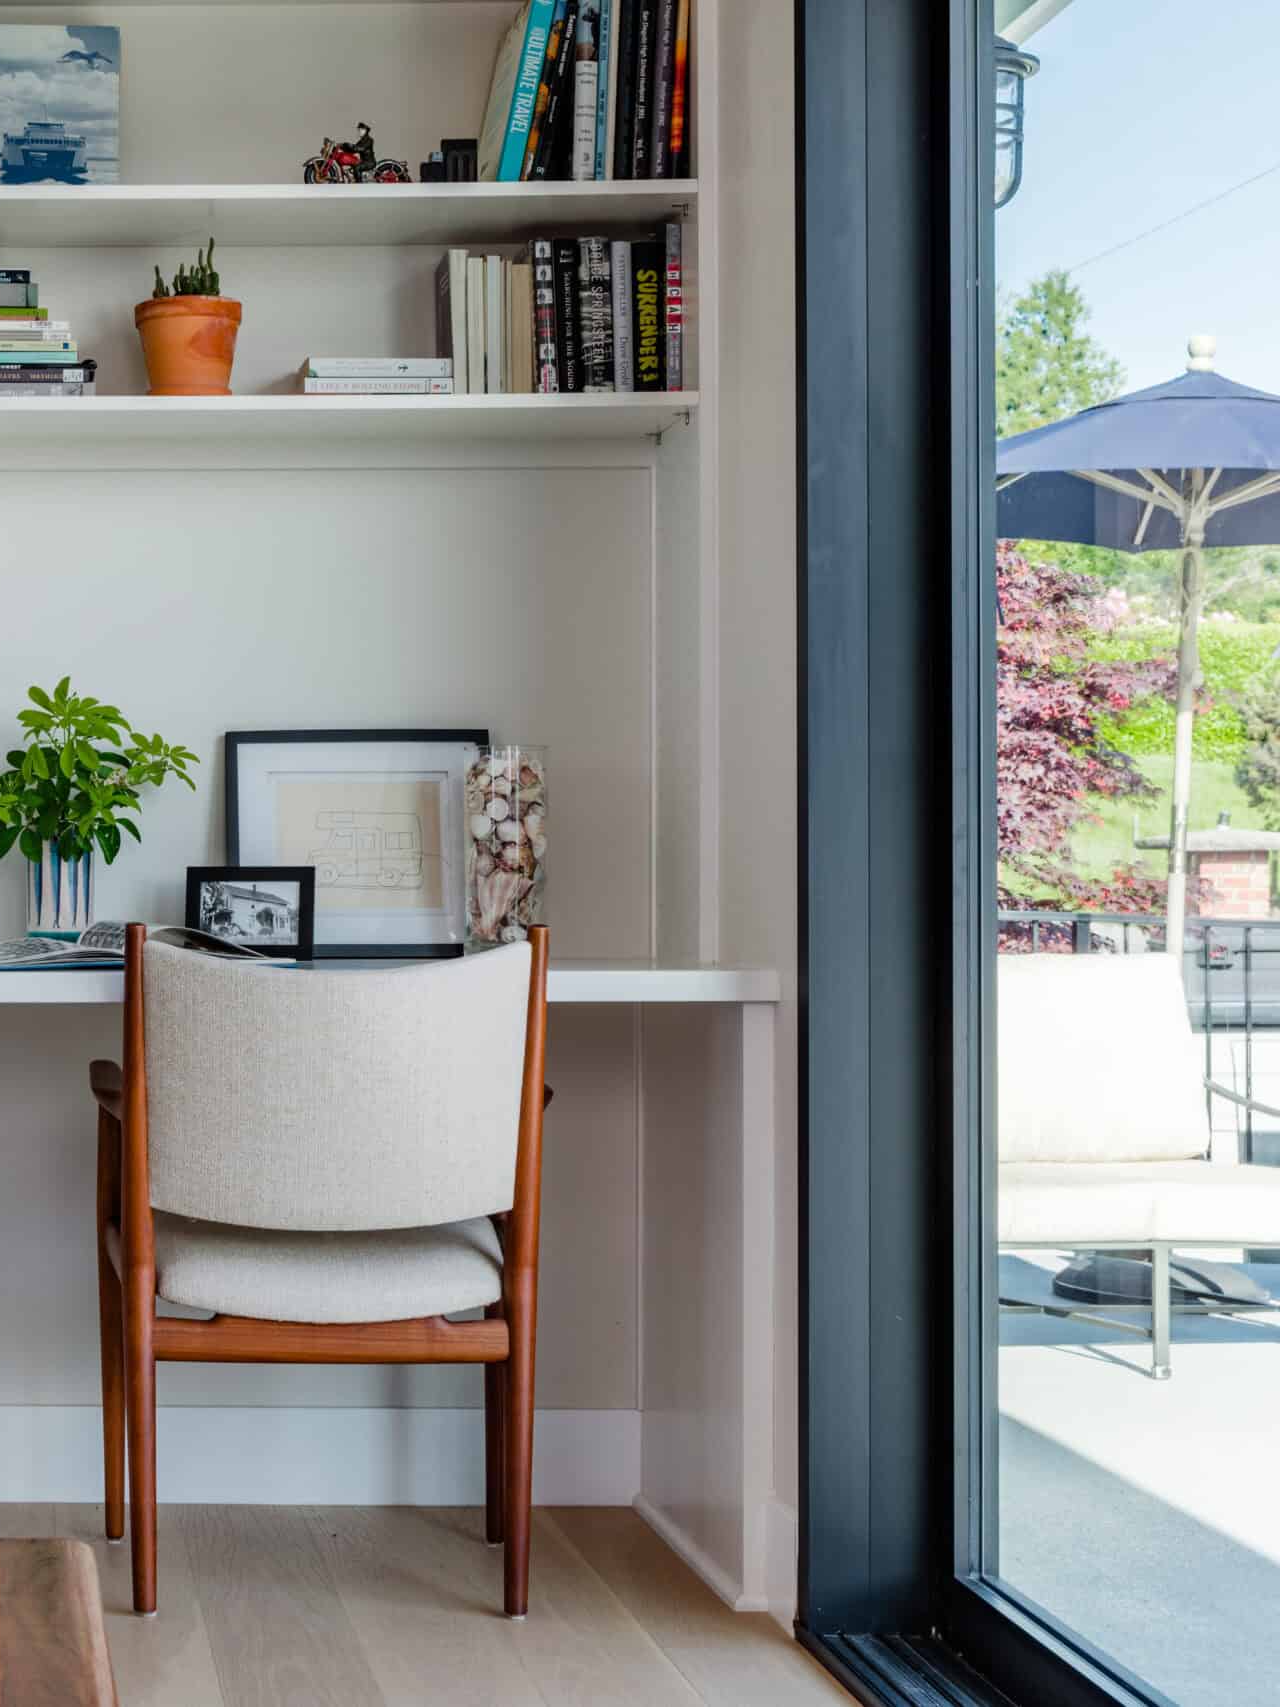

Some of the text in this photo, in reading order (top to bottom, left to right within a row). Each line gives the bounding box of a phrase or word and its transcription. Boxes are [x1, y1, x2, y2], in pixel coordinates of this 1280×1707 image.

[565, 15, 577, 39] Seattle
[639, 45, 648, 58] High
[639, 58, 647, 77] School
[510, 35, 545, 135] ULTIMATE TRAVEL
[563, 271, 572, 319] SEARCHING
[591, 286, 606, 363] SPRINGSTEEN
[637, 269, 658, 370] SURRENDER
[567, 360, 577, 390] SOUND
